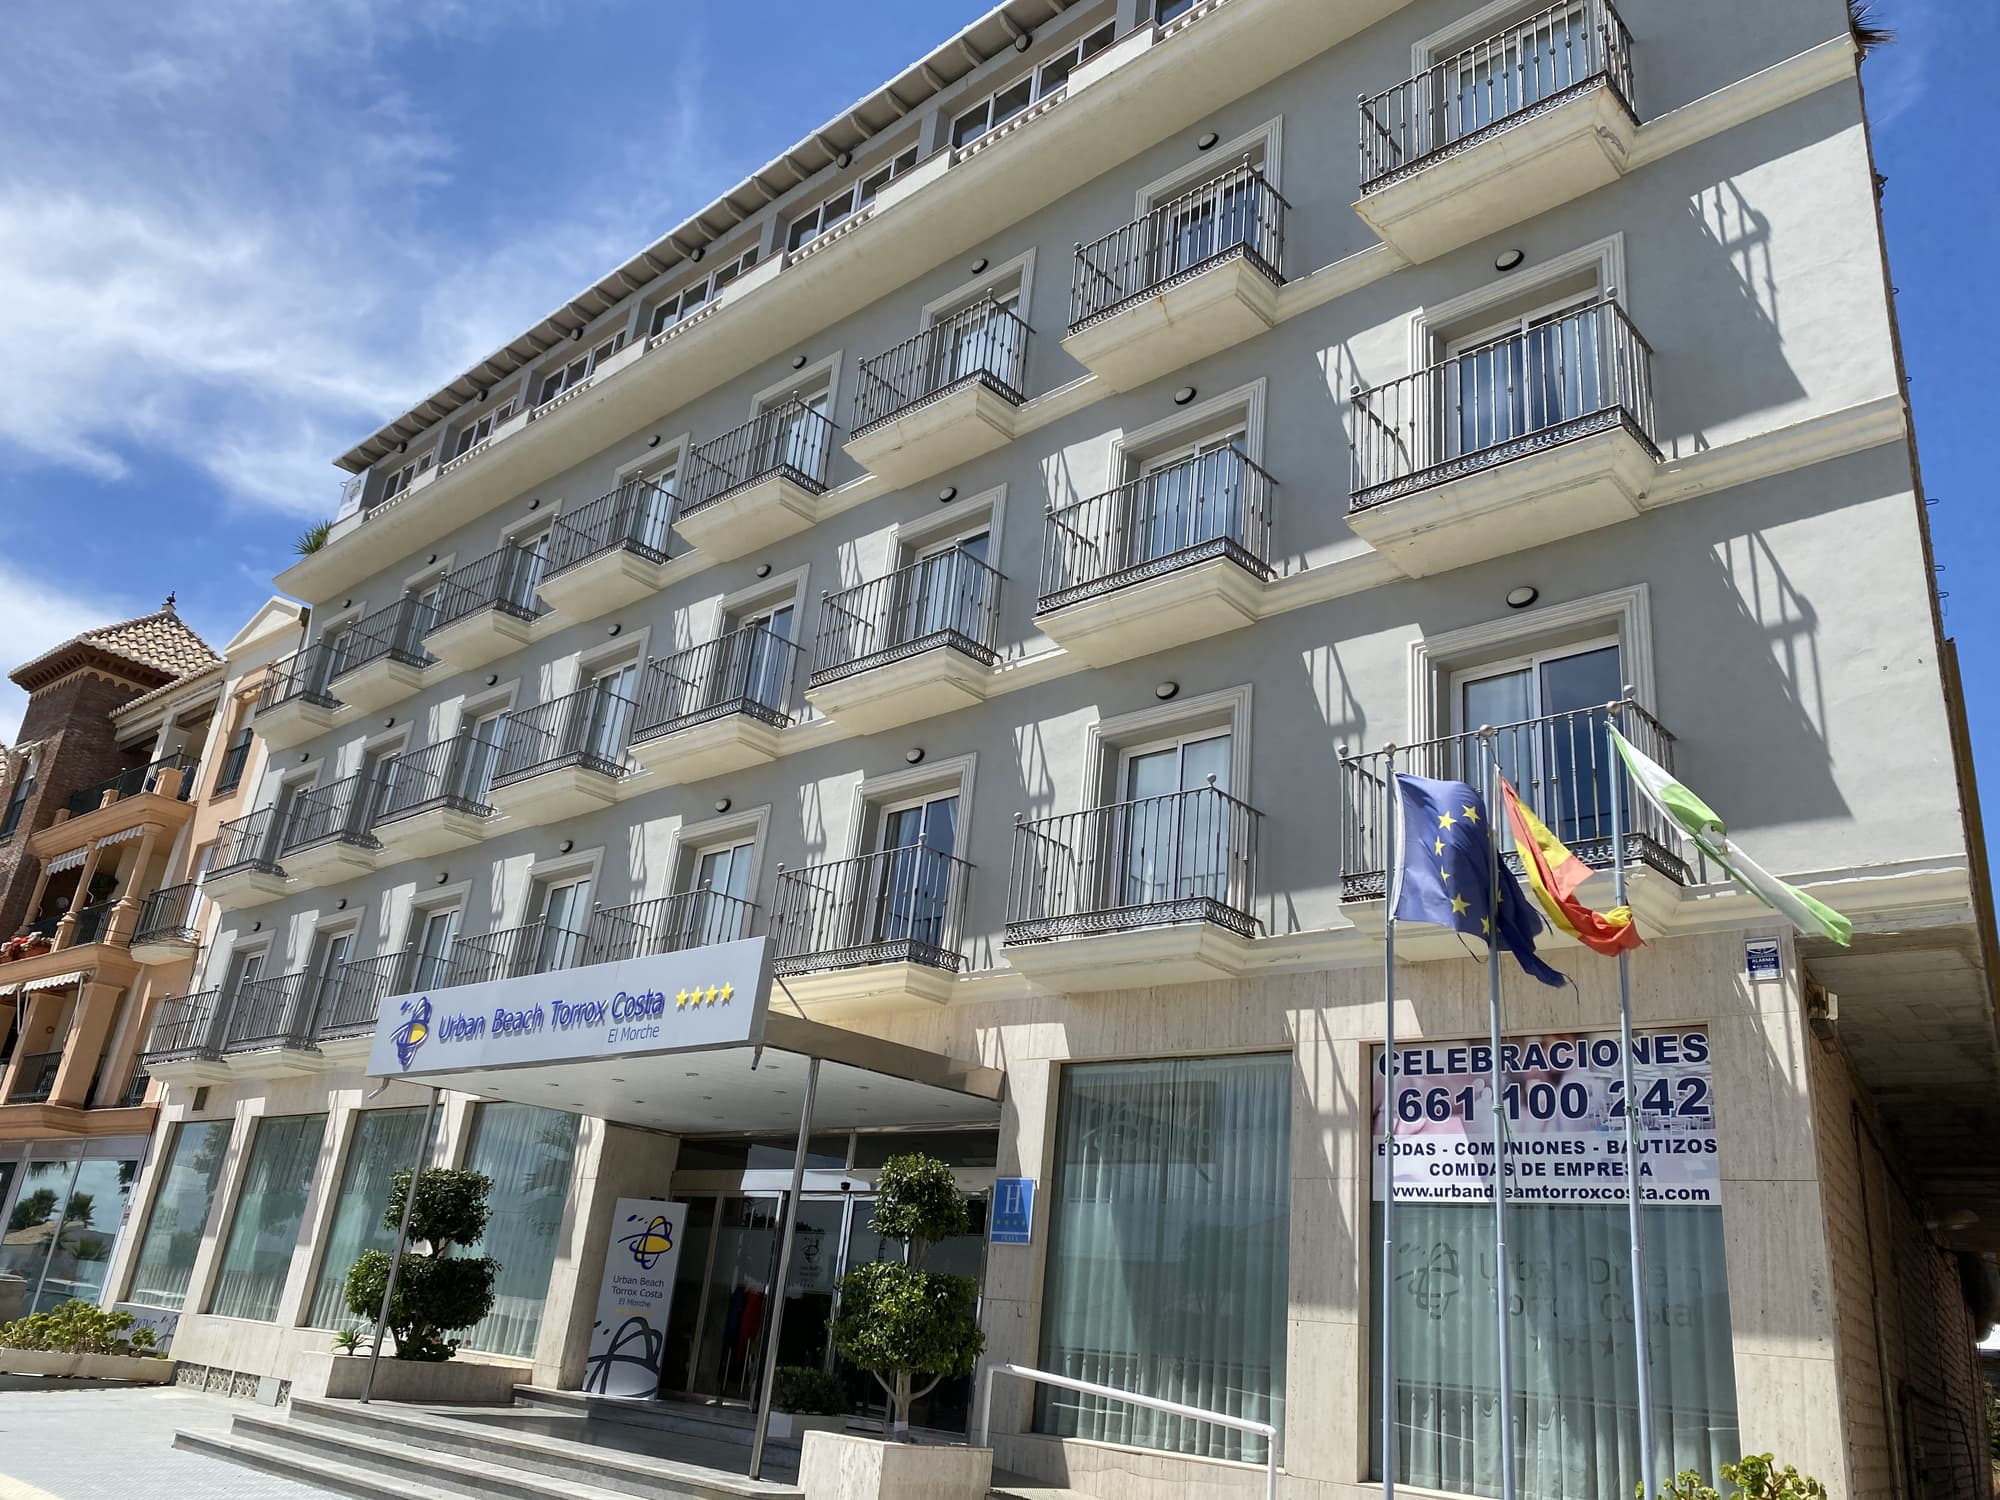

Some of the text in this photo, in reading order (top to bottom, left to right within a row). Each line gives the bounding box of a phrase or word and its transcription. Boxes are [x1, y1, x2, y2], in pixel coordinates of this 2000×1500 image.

[439, 988, 666, 1040] Urban Beach Torrox Costa
[607, 1024, 660, 1043] El Morche
[1378, 1033, 1709, 1077] CELEBRACIONES
[1398, 1077, 1709, 1122] 661 100 242
[1377, 1143, 1436, 1156] BODAS
[1521, 1162, 1546, 1176] DE
[1003, 1184, 1024, 1215] H
[1393, 1183, 1710, 1201] ww.urbandeamtorroxcota.com
[612, 1275, 665, 1288] Urban Beach
[611, 1285, 663, 1299] Torrox Costa
